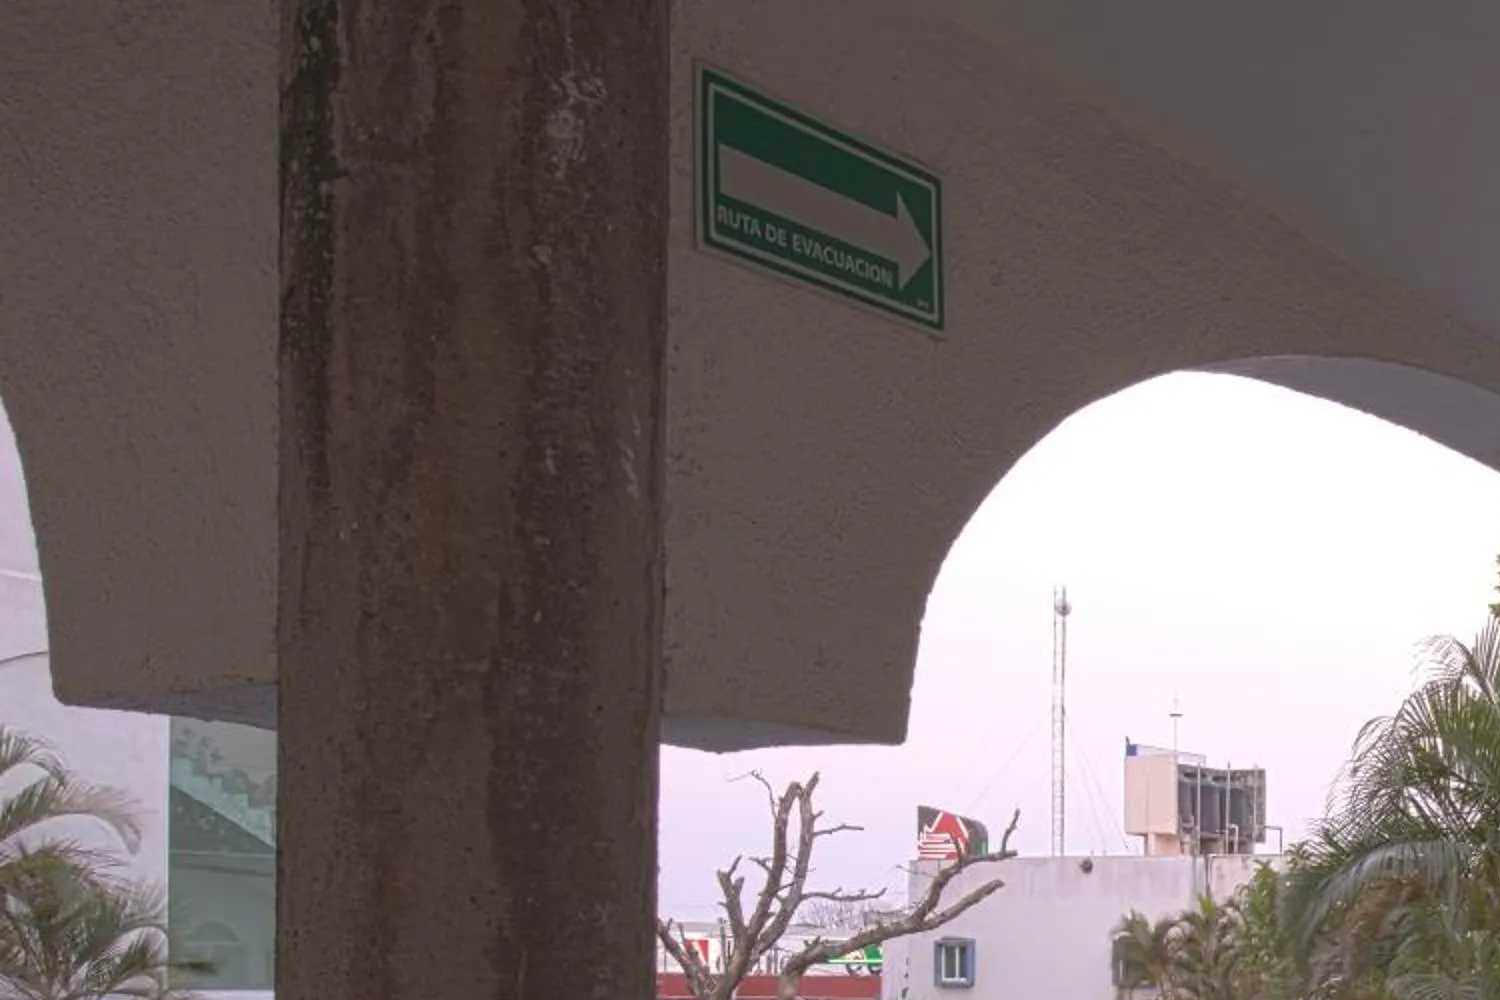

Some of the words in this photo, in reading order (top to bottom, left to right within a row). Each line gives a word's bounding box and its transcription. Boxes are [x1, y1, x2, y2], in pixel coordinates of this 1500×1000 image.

[717, 205, 761, 239] RUTA
[765, 223, 787, 248] DE
[792, 234, 893, 288] EVACUACION
